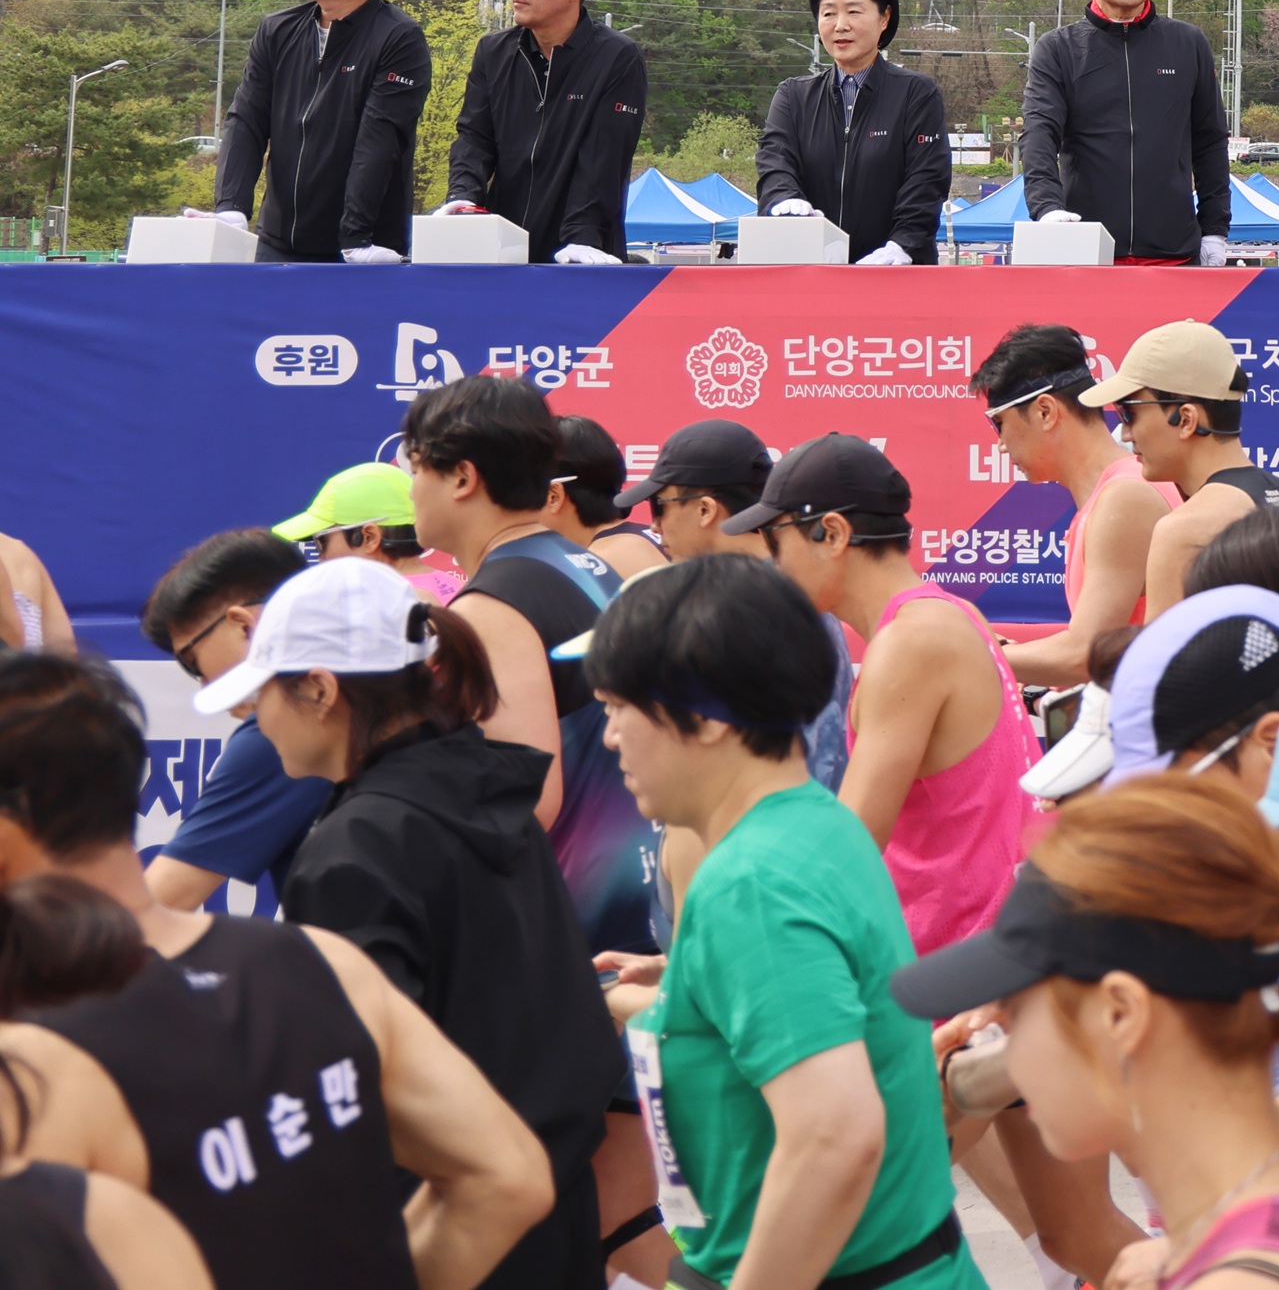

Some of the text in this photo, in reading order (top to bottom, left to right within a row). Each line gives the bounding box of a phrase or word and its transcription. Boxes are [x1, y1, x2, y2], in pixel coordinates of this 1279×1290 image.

[395, 75, 414, 86] ELLE
[622, 105, 638, 114] ELLE
[272, 344, 340, 377] 후원
[488, 345, 613, 389] 단양군
[714, 362, 742, 377] 의회
[783, 335, 972, 377] 단양군의회
[921, 529, 1066, 566] 단양경찰서
[921, 573, 976, 584] DANYANG
[979, 573, 1019, 584] POLICE
[650, 1098, 680, 1175] 10km
